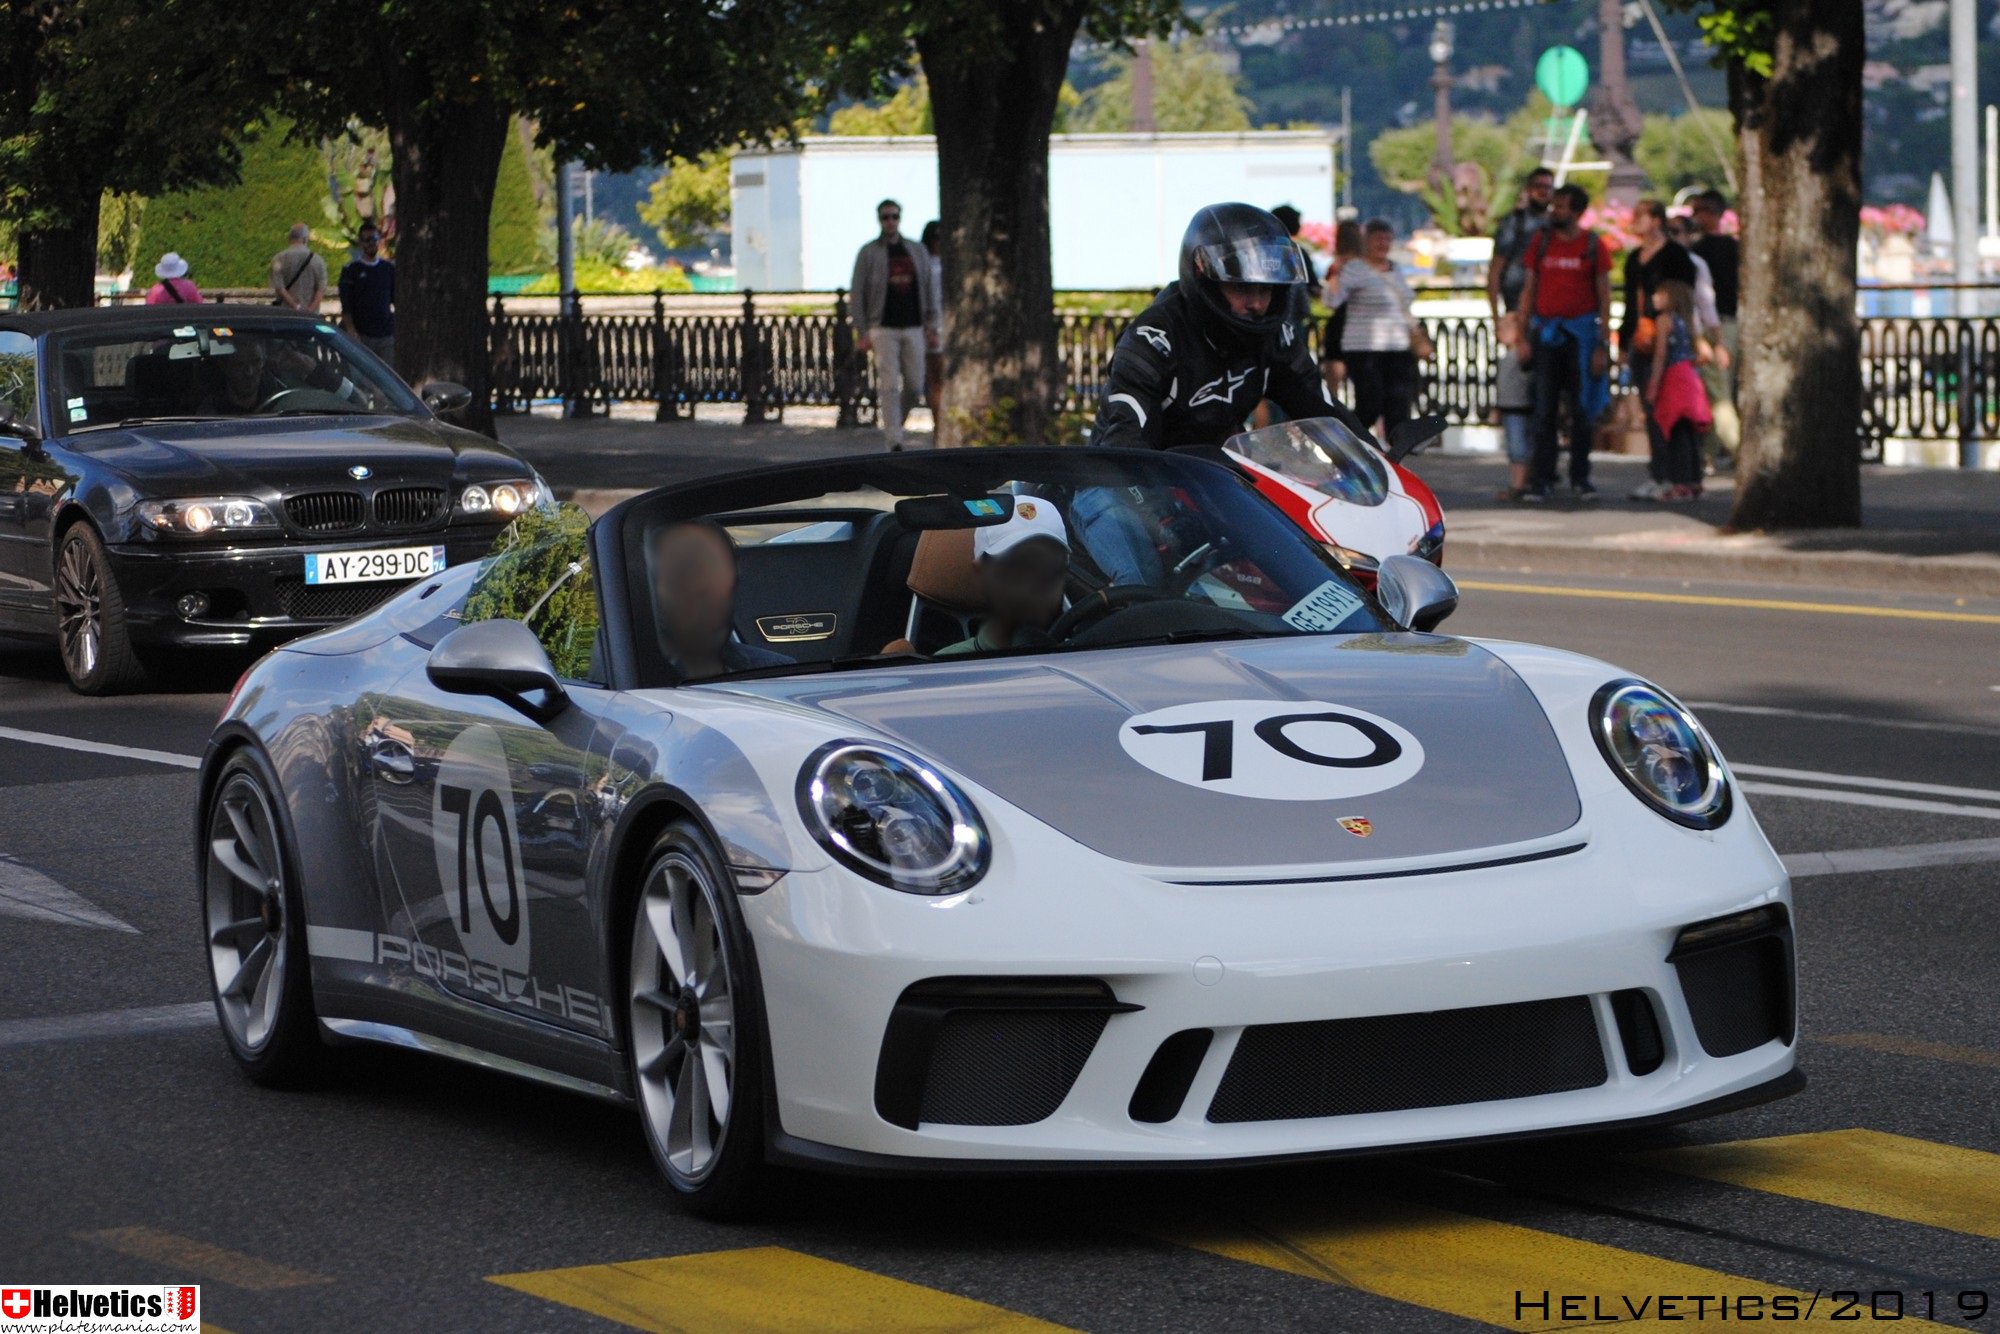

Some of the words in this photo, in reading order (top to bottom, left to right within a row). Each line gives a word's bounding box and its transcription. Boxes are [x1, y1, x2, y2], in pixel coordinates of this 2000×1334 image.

[1130, 712, 1402, 781] 70
[441, 784, 520, 945] 70
[378, 933, 603, 1028] PORSCHE
